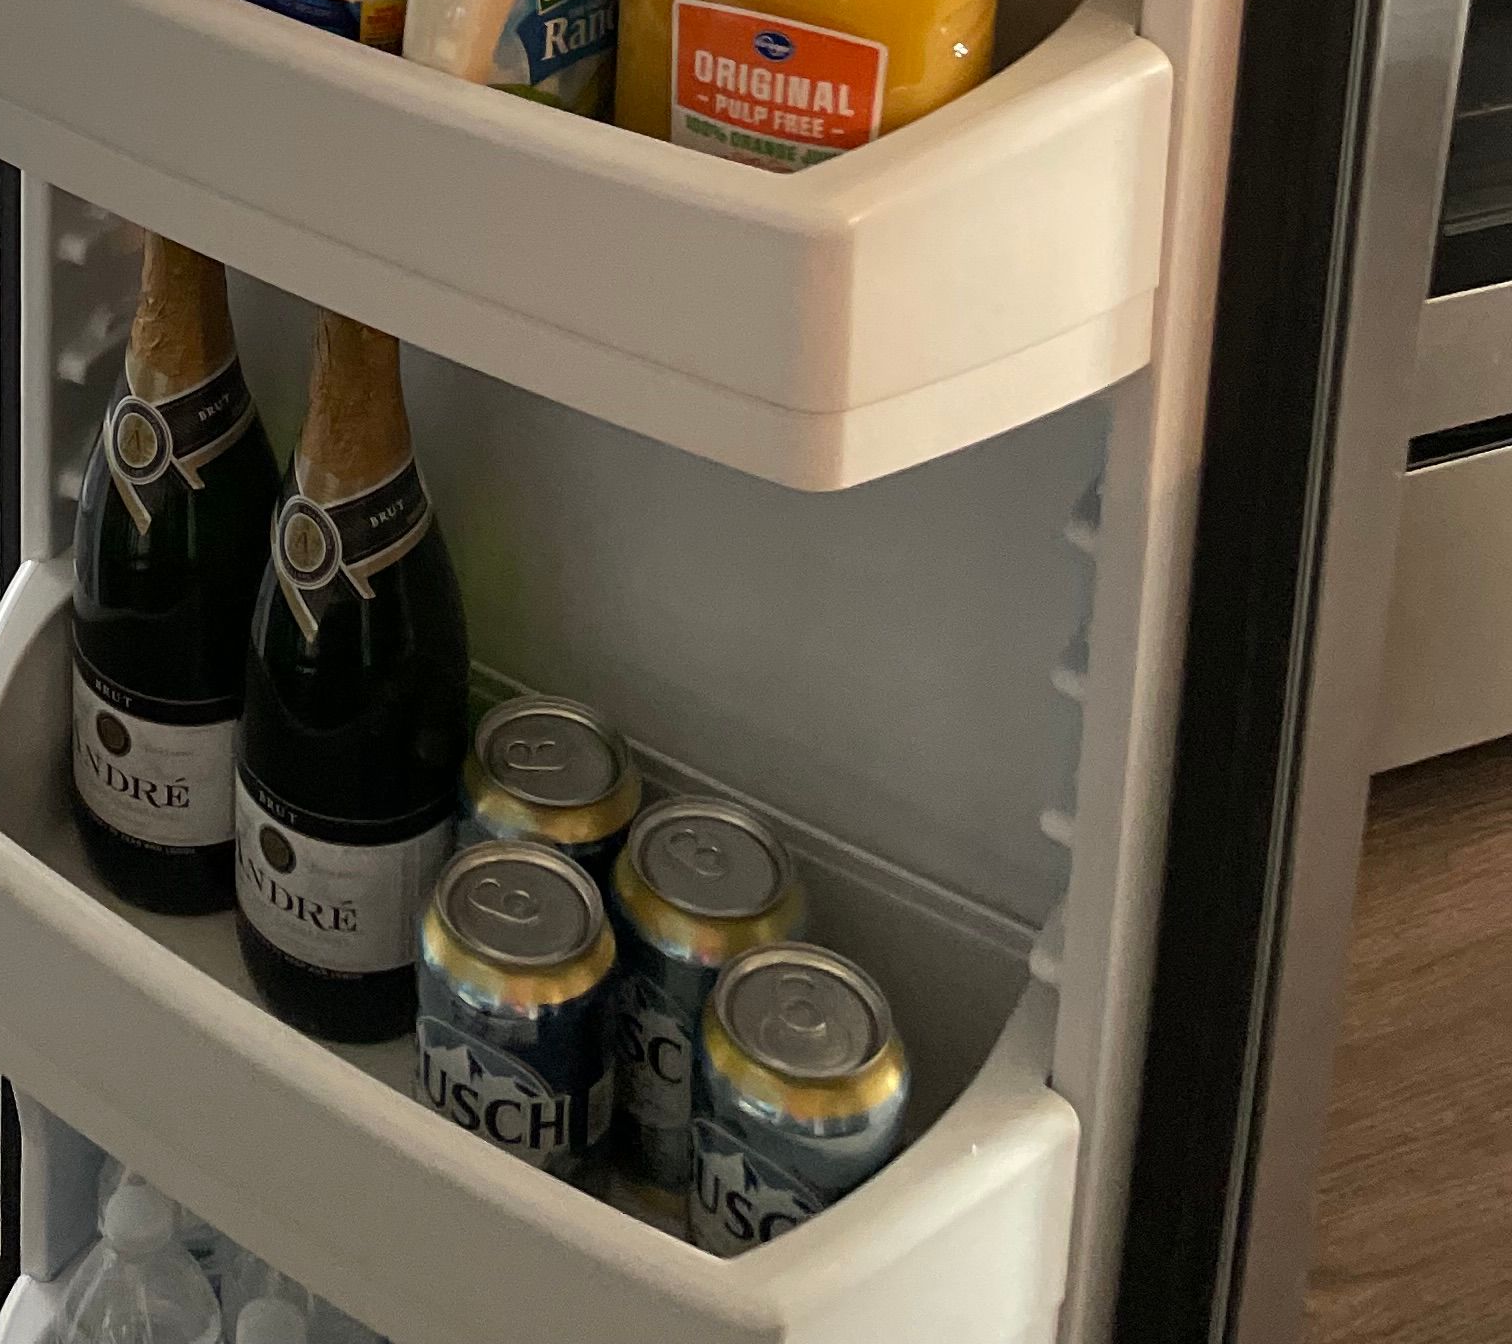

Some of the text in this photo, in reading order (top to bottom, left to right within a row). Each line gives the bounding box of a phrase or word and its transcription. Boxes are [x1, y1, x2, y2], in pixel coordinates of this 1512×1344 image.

[694, 49, 856, 118] ORIGINAL
[715, 93, 825, 139] PULP FREE
[197, 392, 232, 422] BRUT
[369, 500, 406, 529] BRUT
[95, 678, 133, 709] BRUT
[259, 790, 298, 825] BRUT
[424, 1050, 566, 1149] USCH
